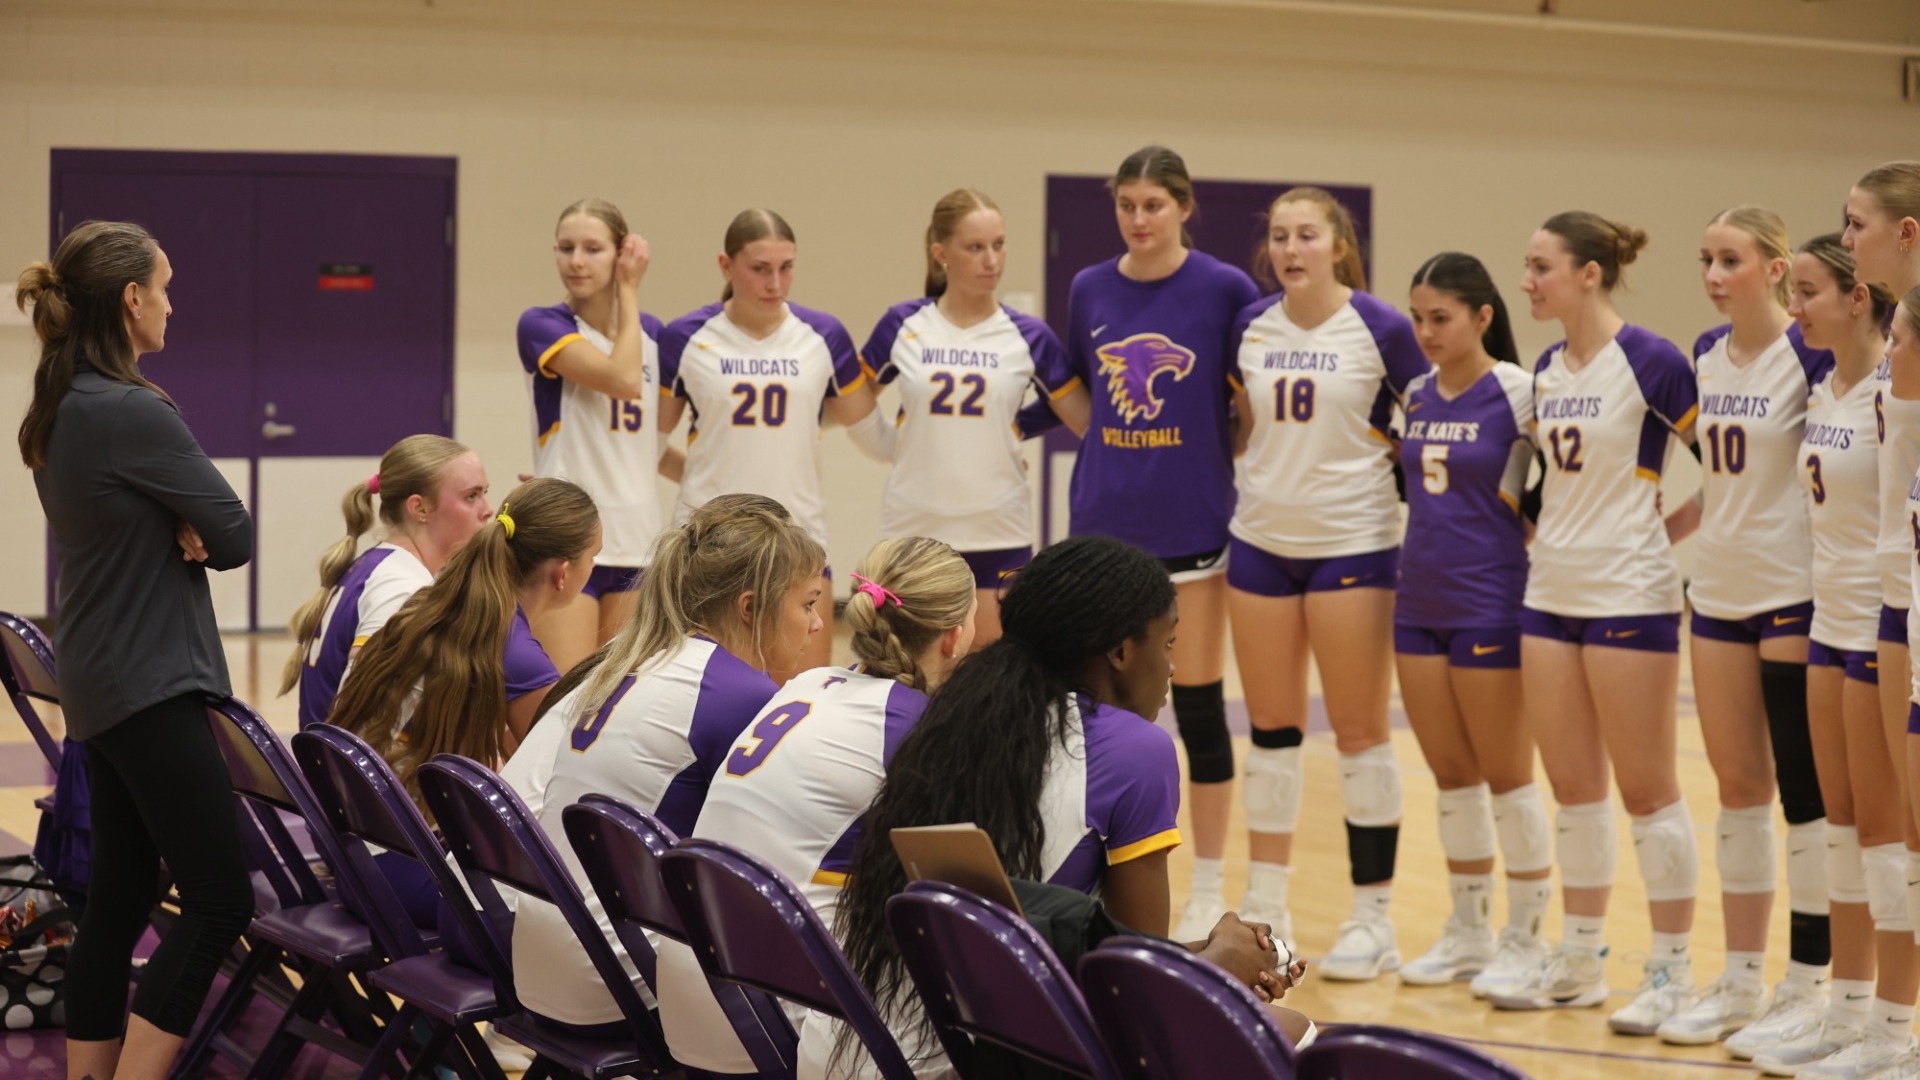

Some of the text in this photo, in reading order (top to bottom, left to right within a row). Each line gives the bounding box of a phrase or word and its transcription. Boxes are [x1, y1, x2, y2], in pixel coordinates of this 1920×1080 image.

[720, 358, 799, 376] WILDCATS
[922, 348, 999, 369] WILDCATS
[1263, 350, 1338, 372] WILDCATS
[730, 382, 789, 427] 20
[929, 371, 987, 418] 22
[1274, 376, 1316, 424] 18
[1542, 396, 1602, 419] WILDCATS
[1701, 394, 1770, 418] WILDCATS
[609, 397, 643, 433] 15
[1426, 421, 1480, 442] KATE'S
[1102, 426, 1183, 448] VOLLEYBALL
[1548, 424, 1584, 473] 12
[1707, 422, 1747, 476] 10
[1420, 443, 1450, 495] 5
[1806, 452, 1826, 507] 3
[725, 700, 814, 779] 9
